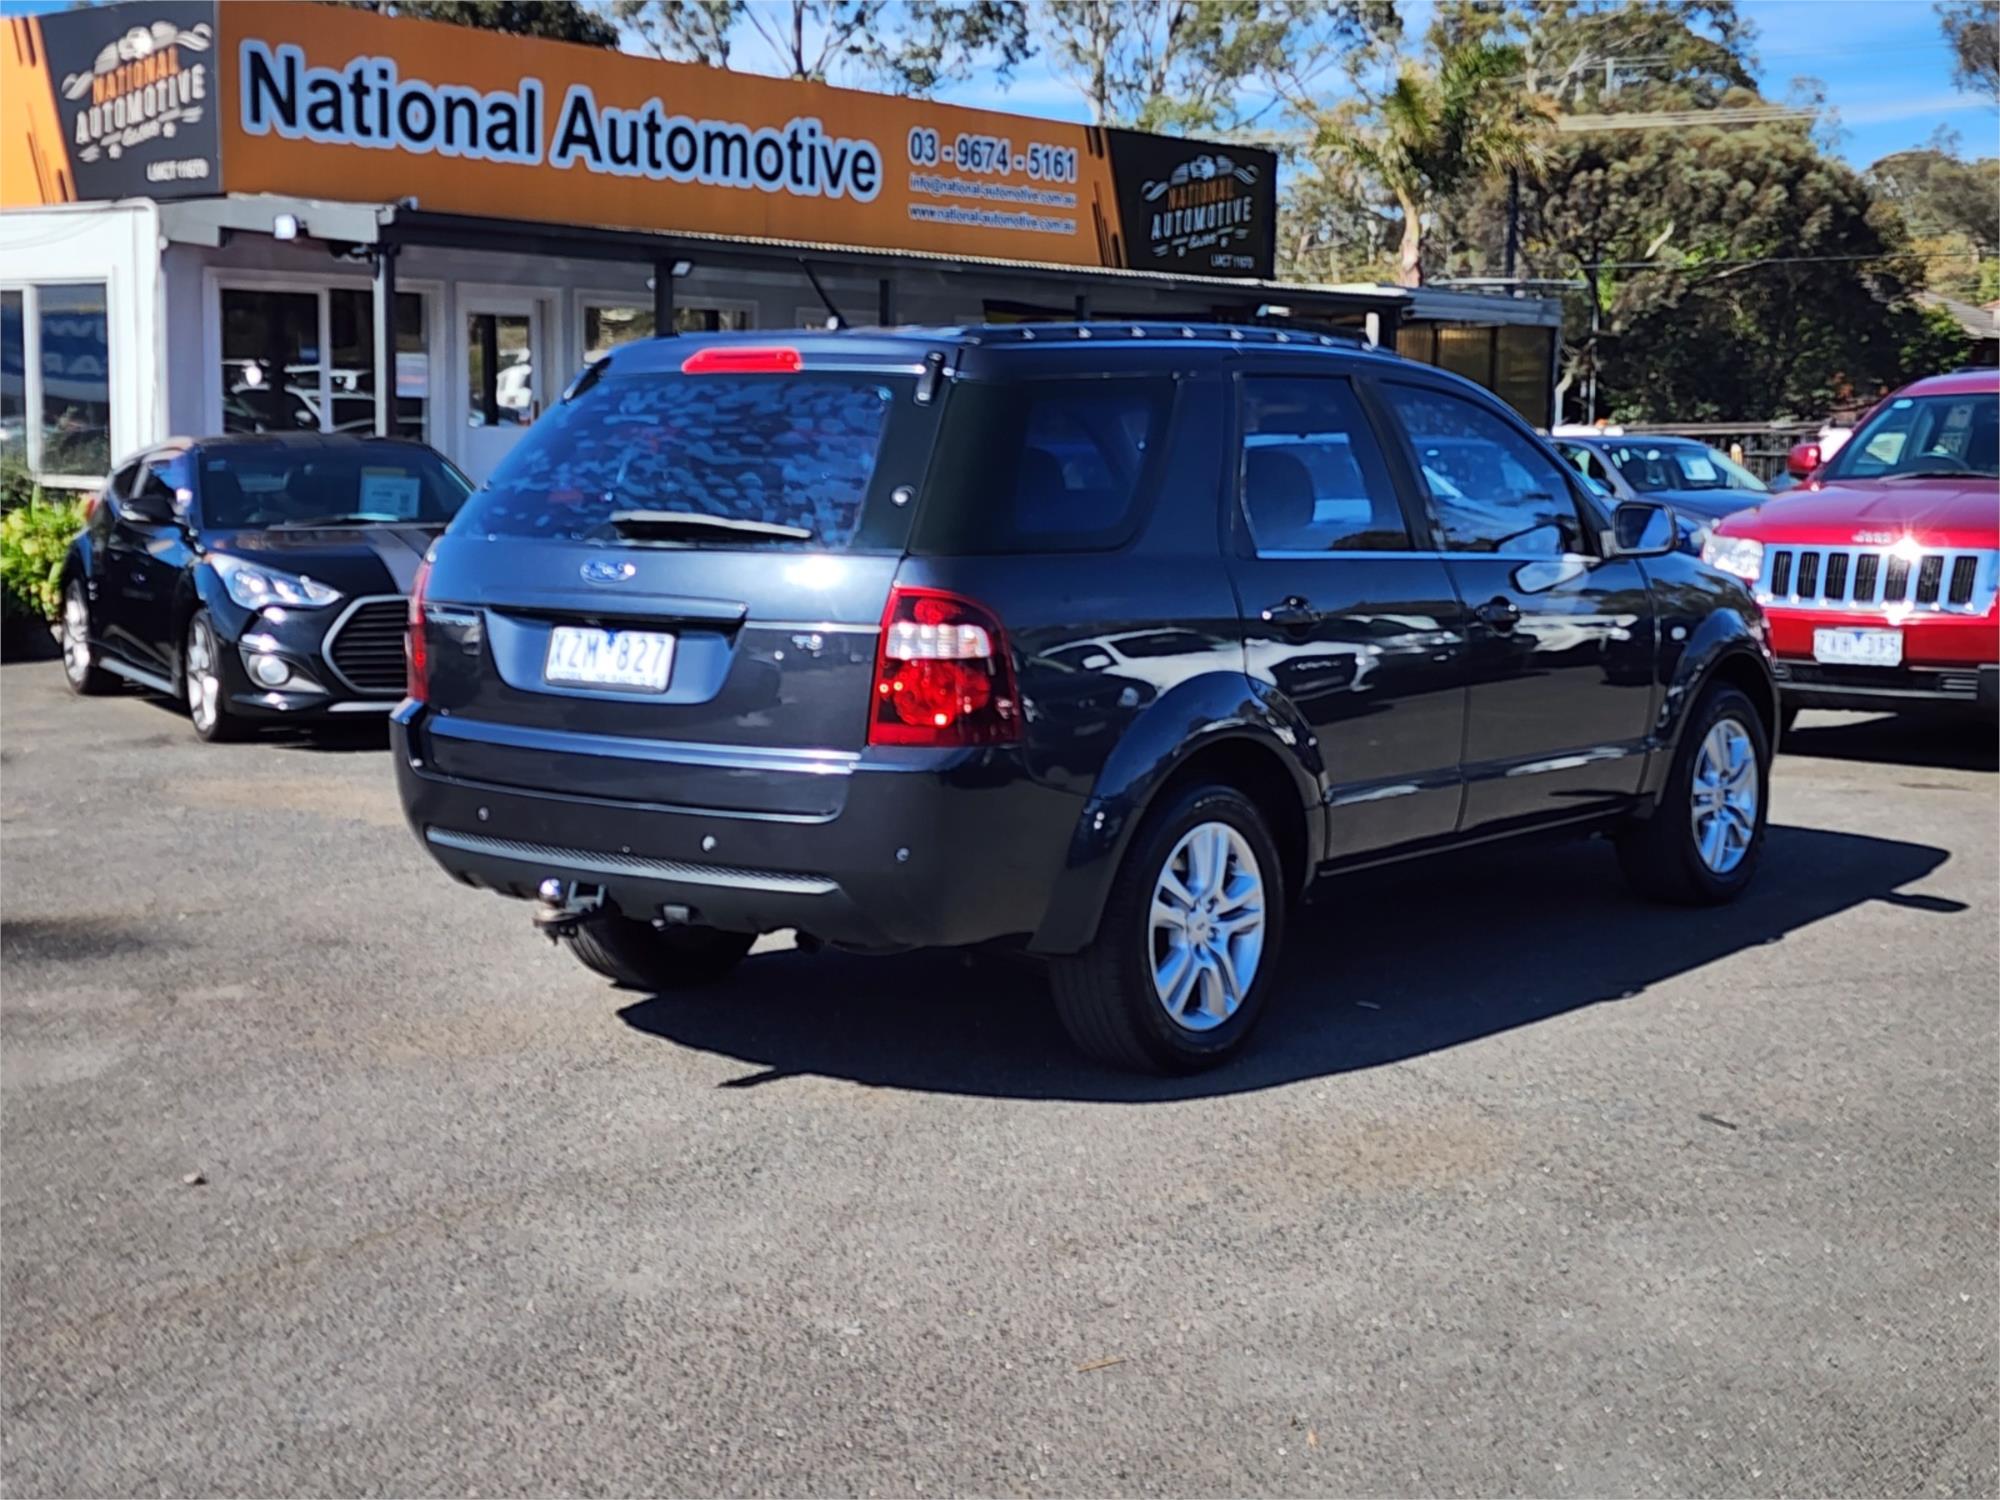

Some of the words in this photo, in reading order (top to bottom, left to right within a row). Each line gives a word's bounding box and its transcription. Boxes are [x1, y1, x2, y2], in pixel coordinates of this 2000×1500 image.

[92, 46, 179, 105] NATIONAL
[76, 64, 206, 145] AUTOMOTIVE
[249, 49, 536, 155] National
[557, 92, 878, 193] Automotive
[910, 131, 937, 164] 03
[956, 137, 1009, 171] 9674
[1028, 147, 1075, 180] 5161
[1151, 196, 1253, 240] AUTOMOTIVE
[1168, 177, 1236, 210] NATIONAL
[616, 637, 666, 673] 827
